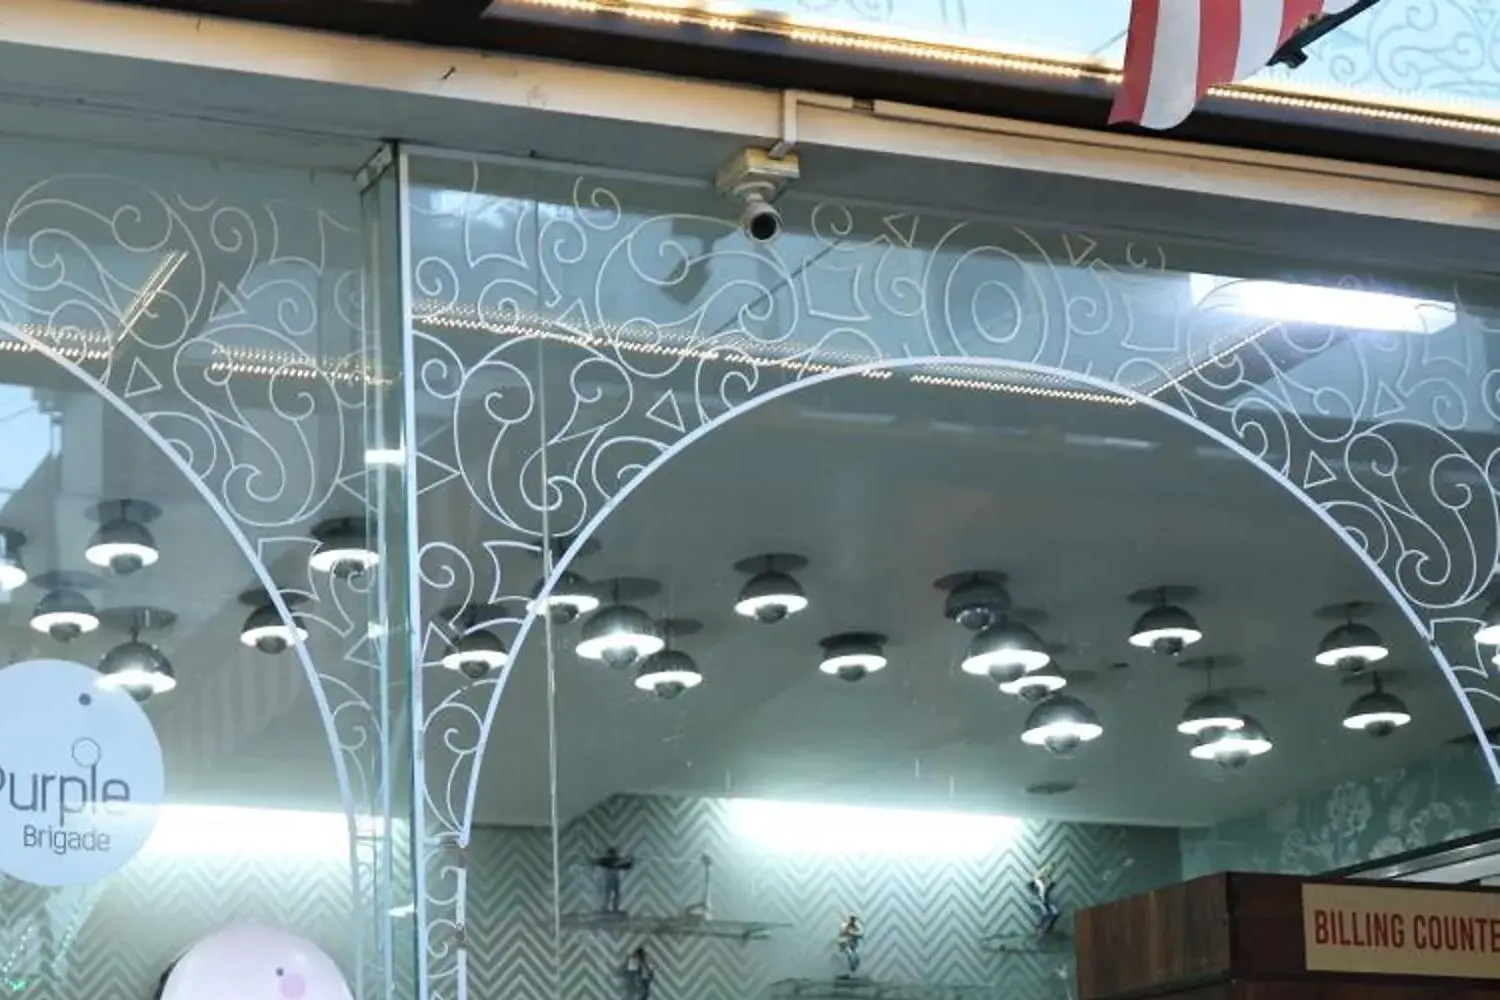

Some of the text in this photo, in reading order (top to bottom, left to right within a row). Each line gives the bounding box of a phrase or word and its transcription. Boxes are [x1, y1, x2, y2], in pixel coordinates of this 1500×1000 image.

[23, 825, 110, 854] Brigade
[1314, 909, 1500, 952] BILLING COUNTE
